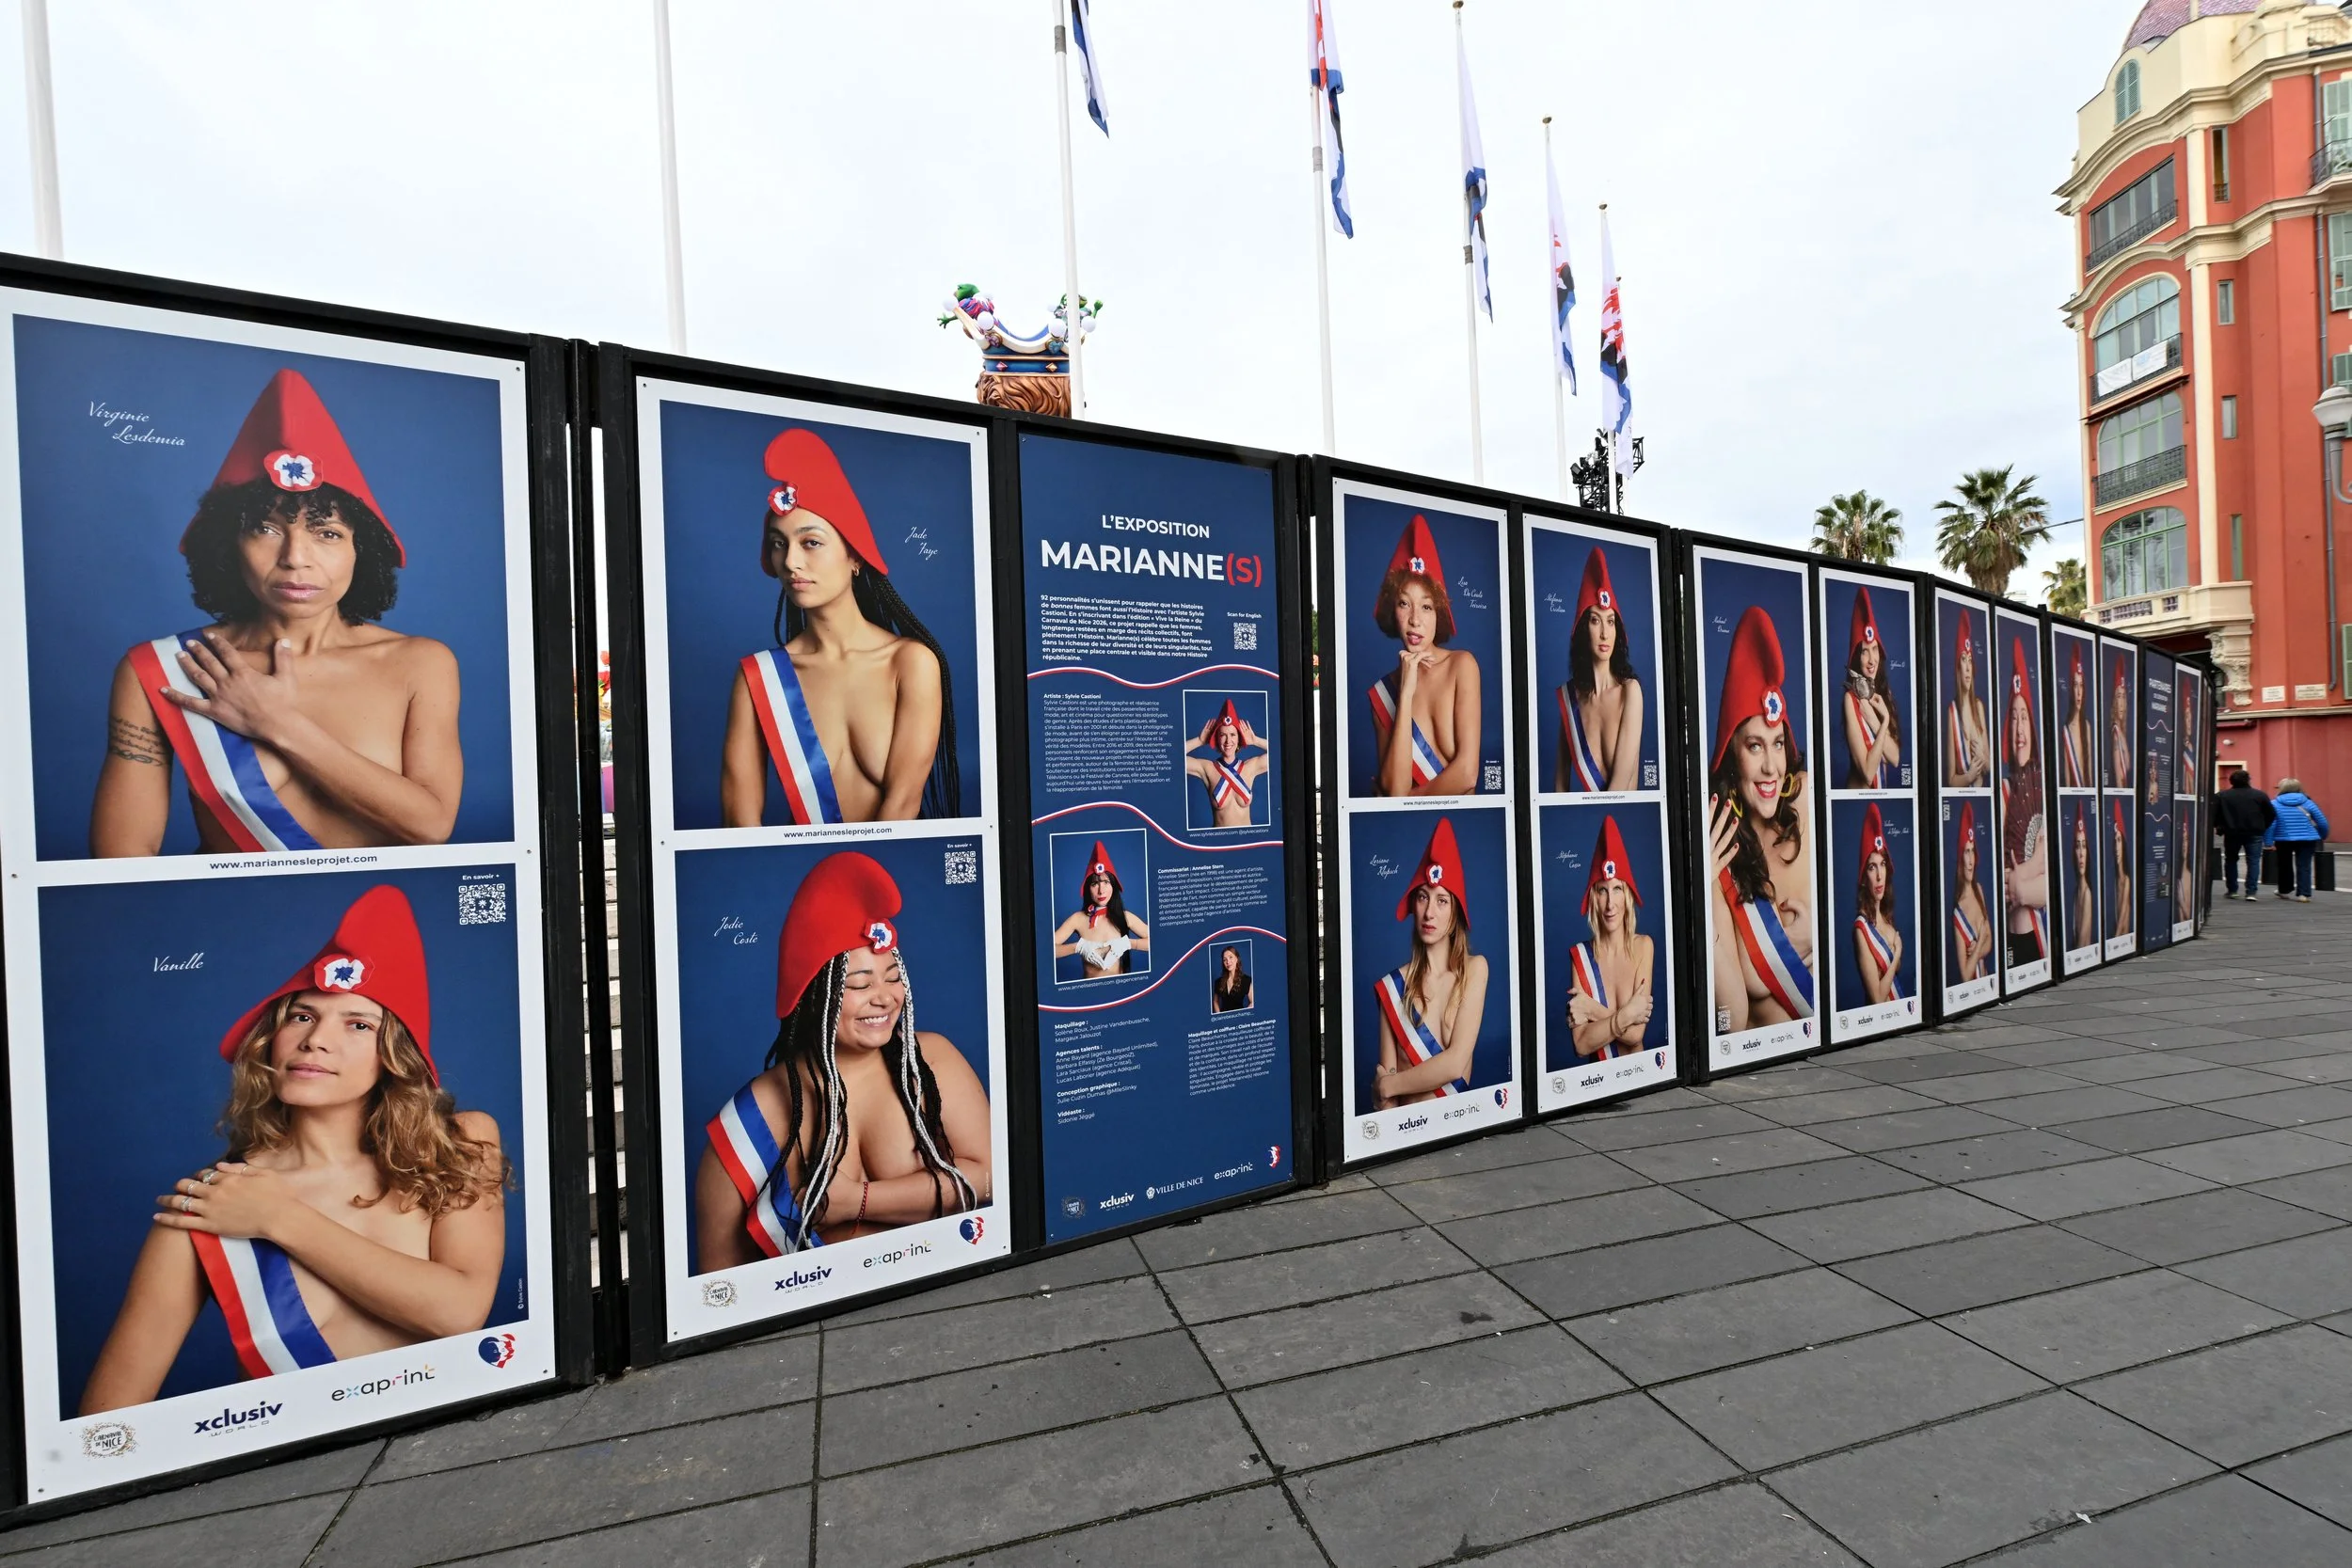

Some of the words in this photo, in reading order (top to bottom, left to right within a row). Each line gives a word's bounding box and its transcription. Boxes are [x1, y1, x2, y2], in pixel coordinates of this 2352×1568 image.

[89, 401, 151, 427] Virginie
[112, 425, 185, 446] Lesdemia
[904, 526, 928, 544] Jade
[1102, 515, 1210, 539] L'EXPOSITION
[1041, 539, 1263, 588] MARIANNE(S)
[784, 828, 893, 839] www.mariannesleprojet.com
[209, 854, 377, 870] www.mariannesleprojet.com
[714, 916, 744, 937] Jodie
[733, 931, 758, 945] Coste
[153, 952, 204, 973] Vanille
[1054, 1021, 1085, 1029] Maquillage
[1742, 1038, 1761, 1051] xclusiv
[1057, 1087, 1089, 1097] Conception
[1089, 1082, 1117, 1092] graphique
[1581, 1073, 1604, 1088] xclusiv
[1057, 1109, 1082, 1117] Vidéaste
[1398, 1116, 1428, 1132] xclusiv
[1214, 1162, 1253, 1180] exaprint
[1155, 1184, 1175, 1196] VILLE
[1176, 1181, 1186, 1192] DE
[1186, 1177, 1204, 1188] NICE
[1099, 1192, 1135, 1210] xclusiv
[864, 1240, 931, 1268] exaprint
[774, 1265, 833, 1291] xclusiv
[330, 1364, 436, 1402] exaprint
[193, 1399, 283, 1434] xclusiv
[208, 1420, 271, 1438] WORLD
[103, 1437, 122, 1448] NICE
